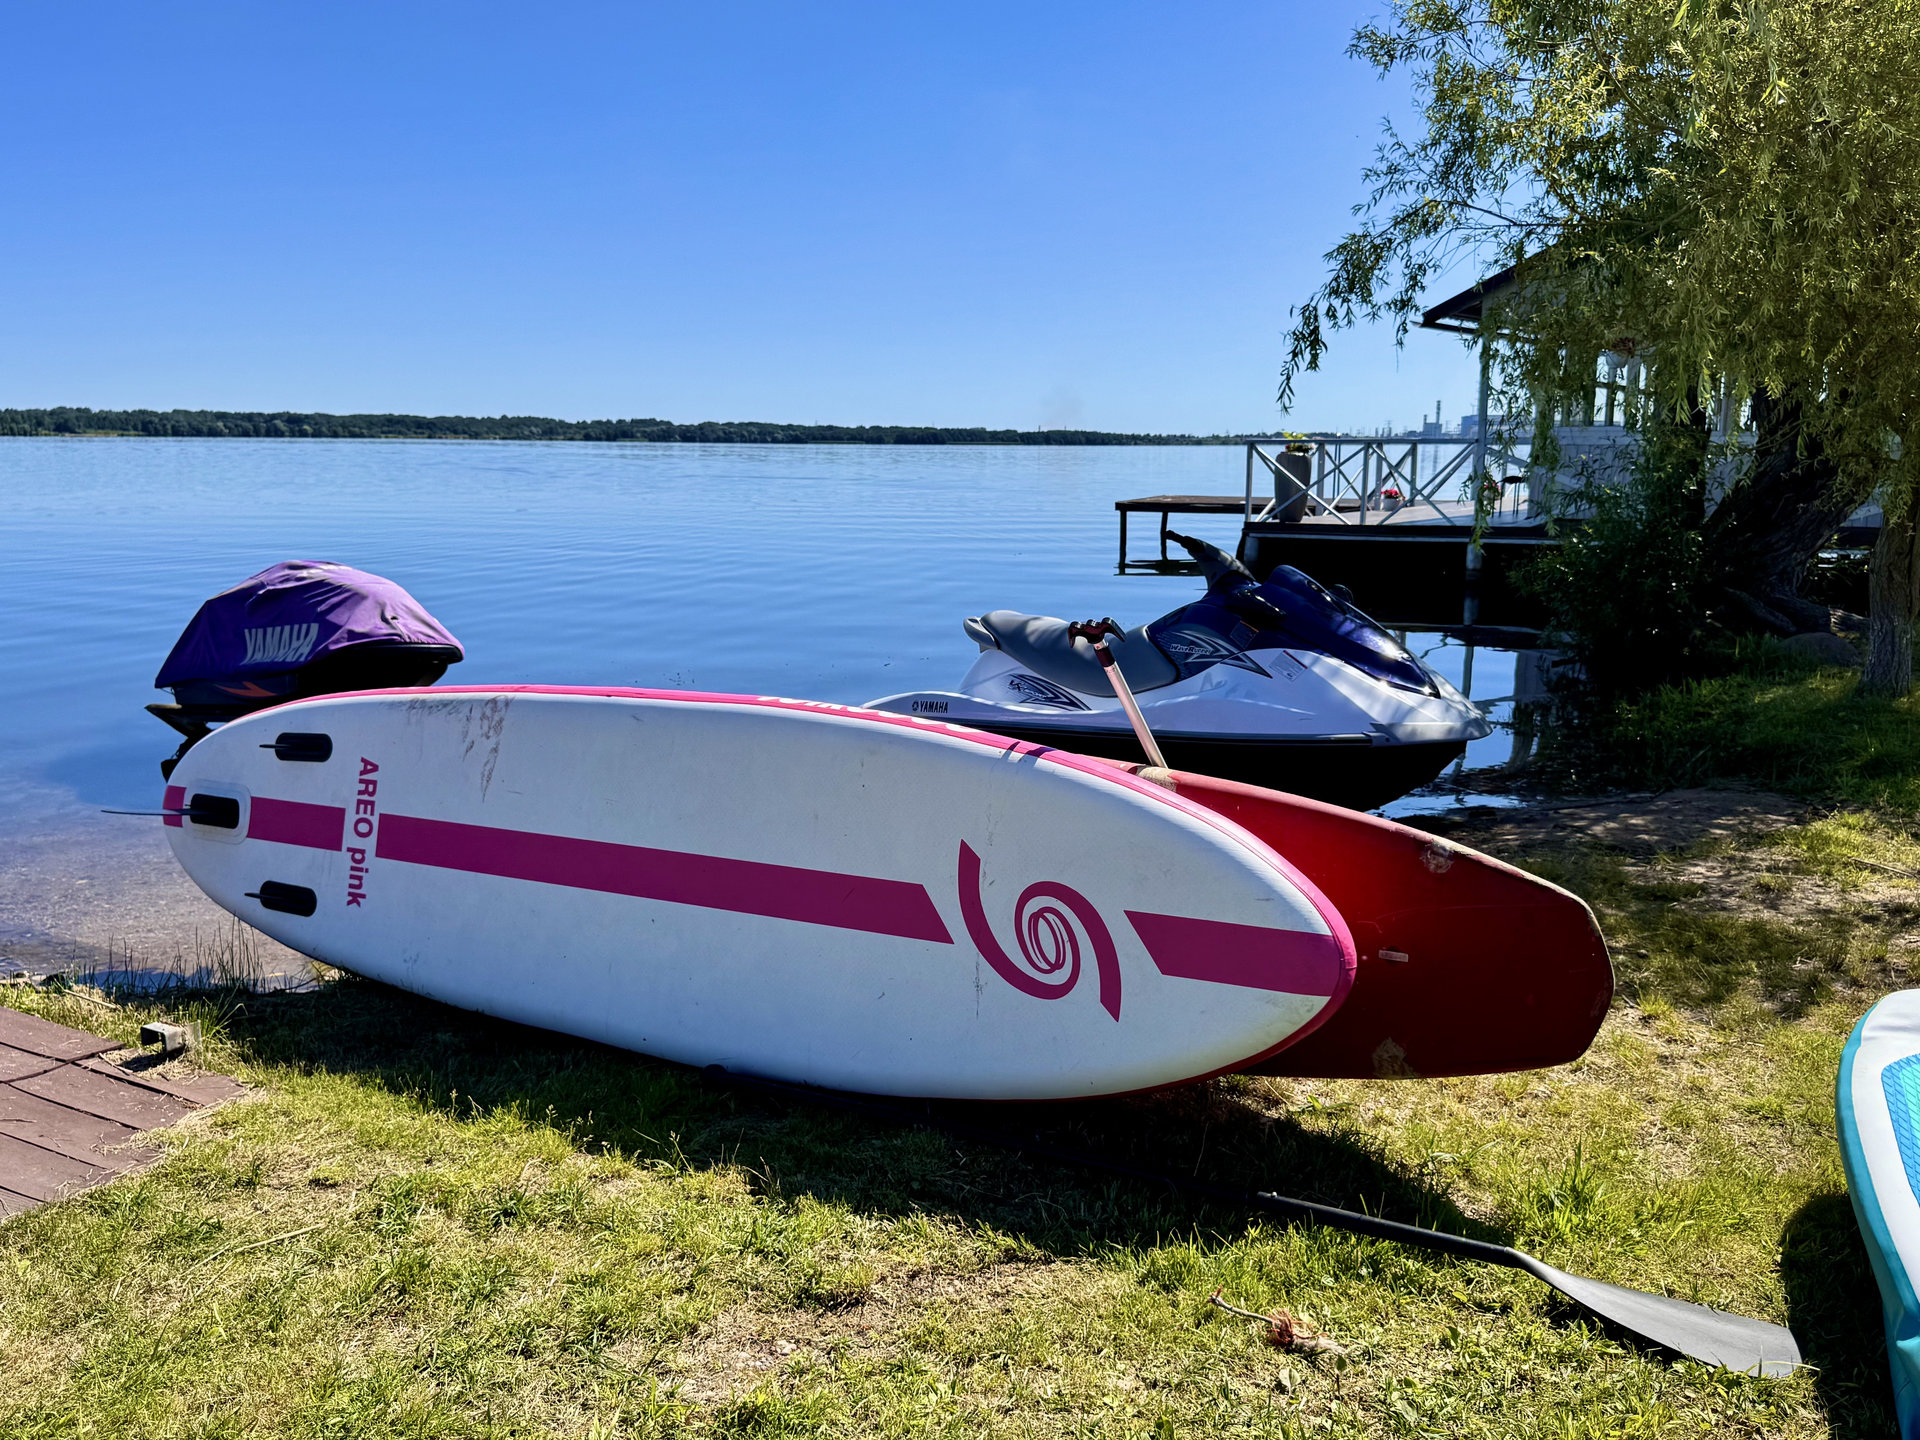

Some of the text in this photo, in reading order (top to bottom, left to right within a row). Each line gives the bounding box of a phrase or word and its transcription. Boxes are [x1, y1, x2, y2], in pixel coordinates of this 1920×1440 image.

[242, 622, 319, 664] YAMAHA
[920, 700, 949, 714] YAMAHA
[346, 756, 379, 908] AREO pink
